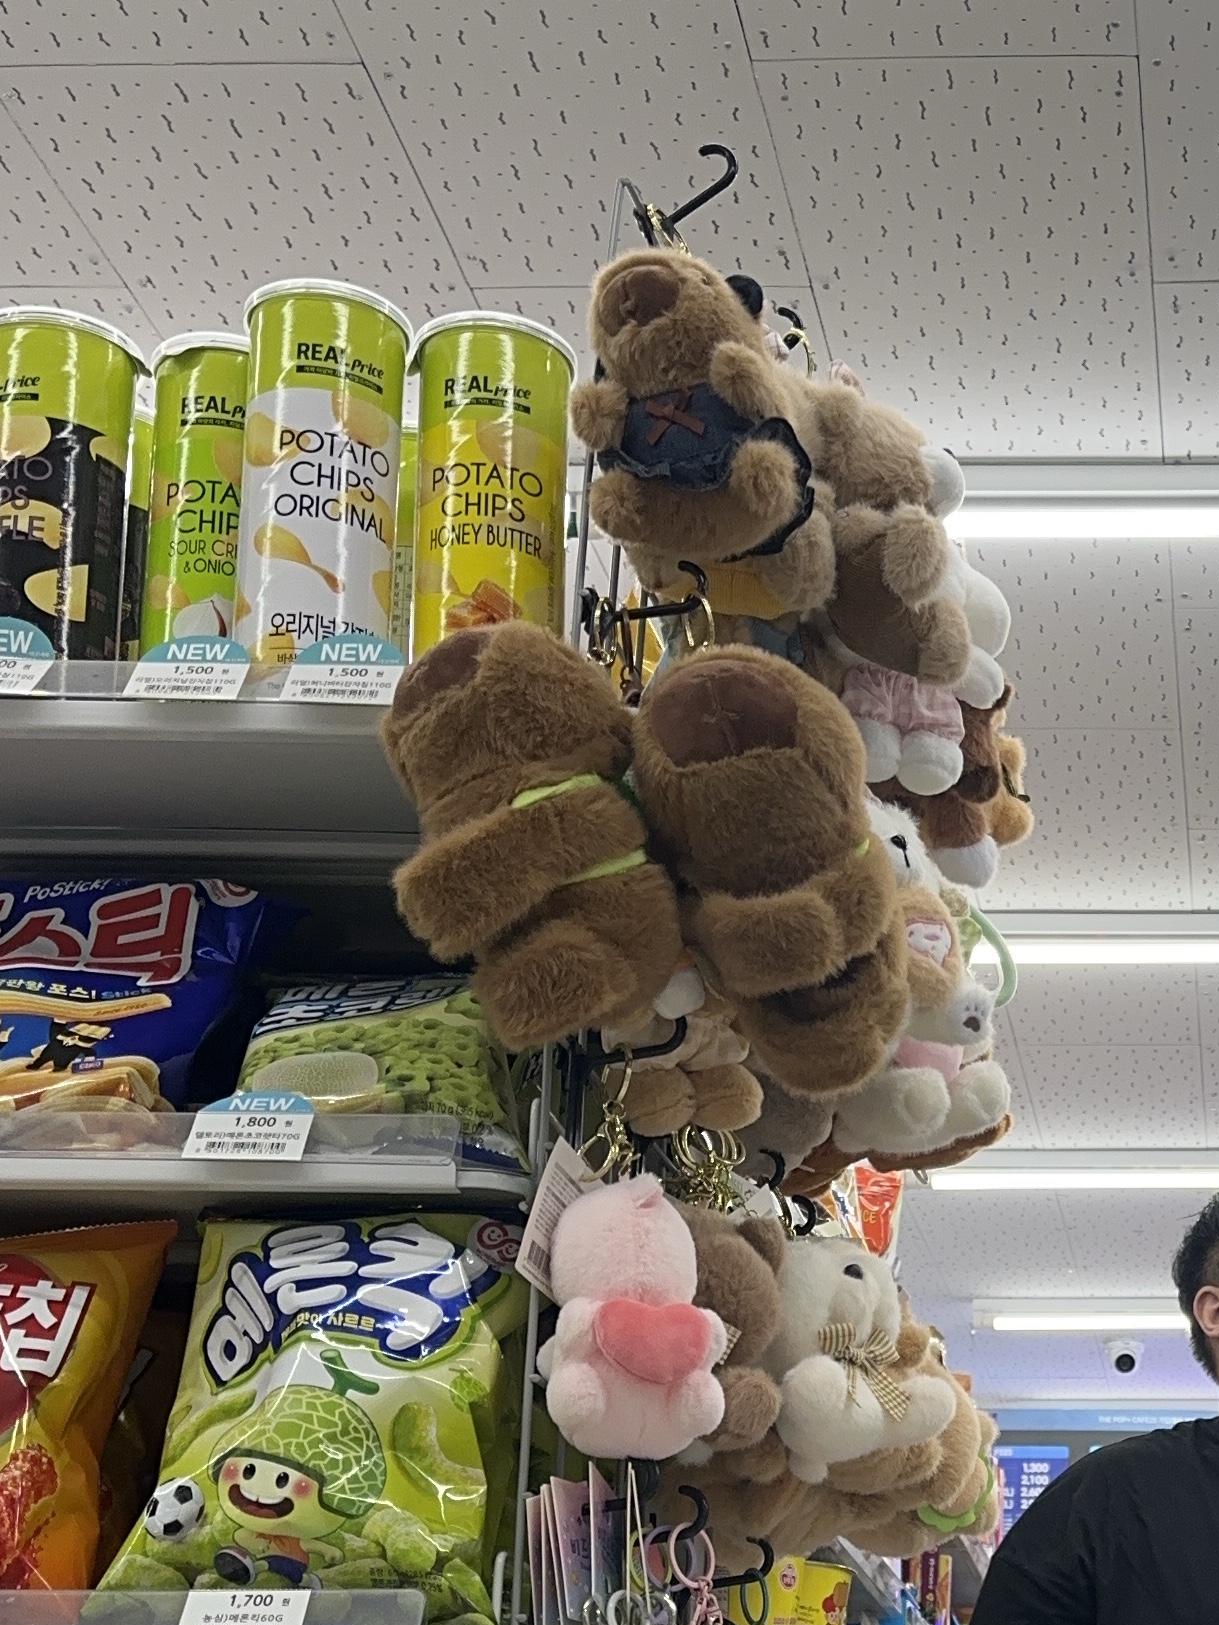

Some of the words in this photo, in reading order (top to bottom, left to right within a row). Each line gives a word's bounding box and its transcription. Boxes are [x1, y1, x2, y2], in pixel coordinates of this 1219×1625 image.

[297, 342, 349, 366] REAL
[351, 358, 384, 380] Price
[444, 375, 493, 396] REAL
[181, 396, 232, 415] REAL
[279, 429, 390, 478] POTATO
[290, 461, 375, 503] CHIPS
[432, 462, 543, 498] POTATO
[441, 491, 526, 522] CHIPS
[274, 494, 387, 544] ORIGINAL
[168, 539, 207, 558] SOUR
[430, 523, 483, 551] HONEY
[486, 523, 542, 557] BUTTER
[183, 561, 191, 574] &
[268, 611, 336, 642] 오리지널
[166, 643, 231, 661] NEW
[320, 643, 383, 662] NEW
[174, 665, 214, 676] 1,500
[328, 668, 369, 679] 1,500
[23, 878, 113, 903] PoStick!
[0, 883, 199, 986] 스틱
[228, 1097, 296, 1112] NEW
[235, 1116, 277, 1129] 1,800
[206, 1223, 489, 1381] 메론킥
[0, 1278, 92, 1379] 칩
[326, 1312, 376, 1332] 사르르
[230, 1594, 274, 1609] 1,700
